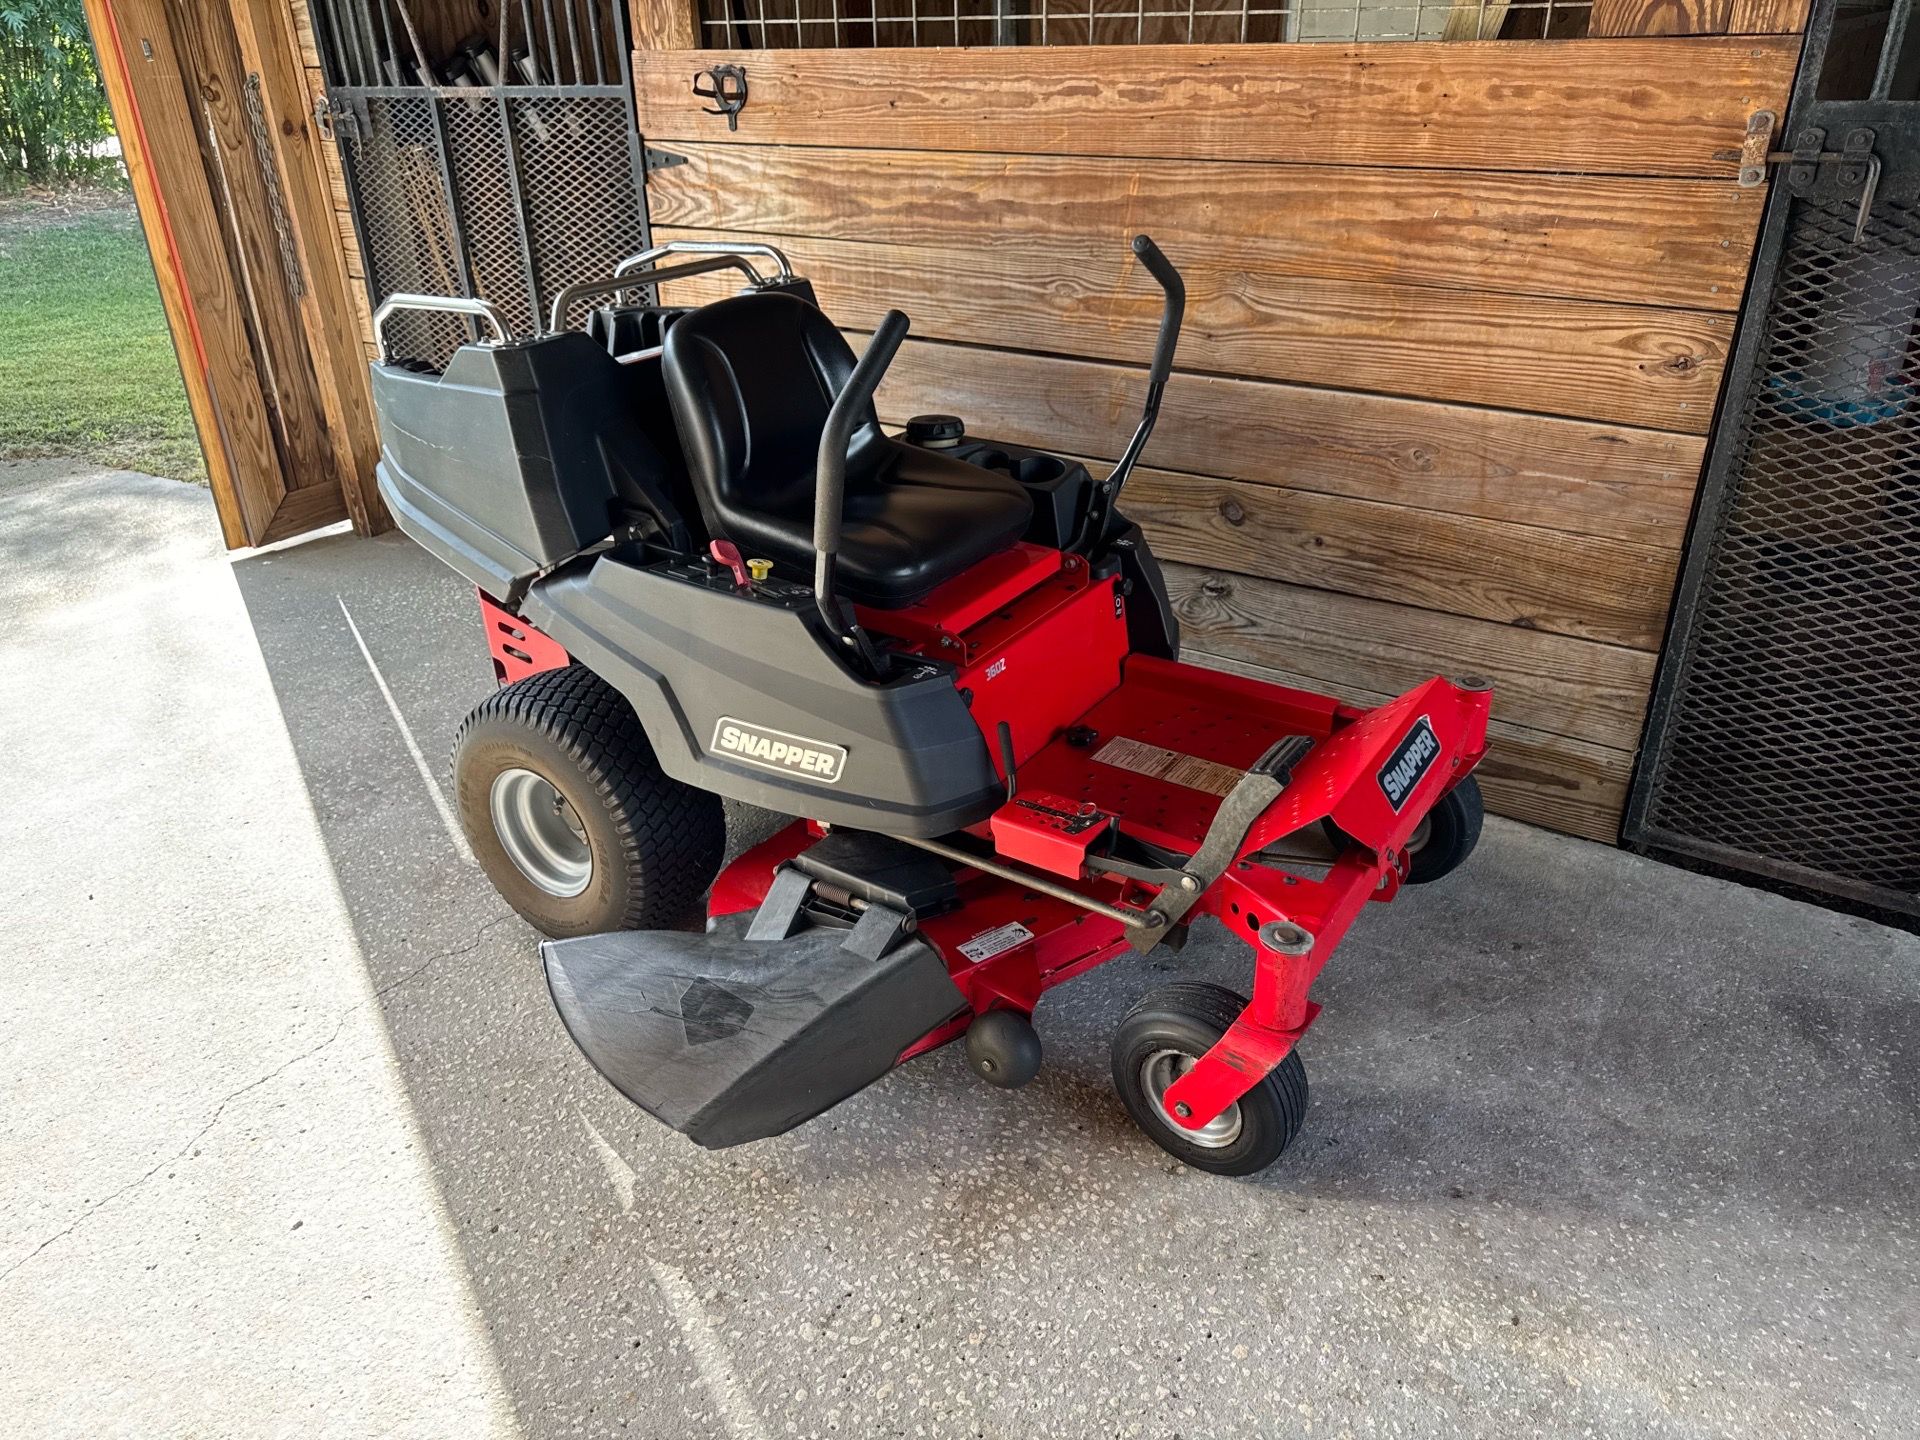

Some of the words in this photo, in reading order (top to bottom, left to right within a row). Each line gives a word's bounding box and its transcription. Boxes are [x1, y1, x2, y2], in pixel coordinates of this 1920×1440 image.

[985, 657, 1007, 681] 360Z
[720, 726, 834, 776] SNAPPER
[1383, 729, 1436, 801] SNAPPER
